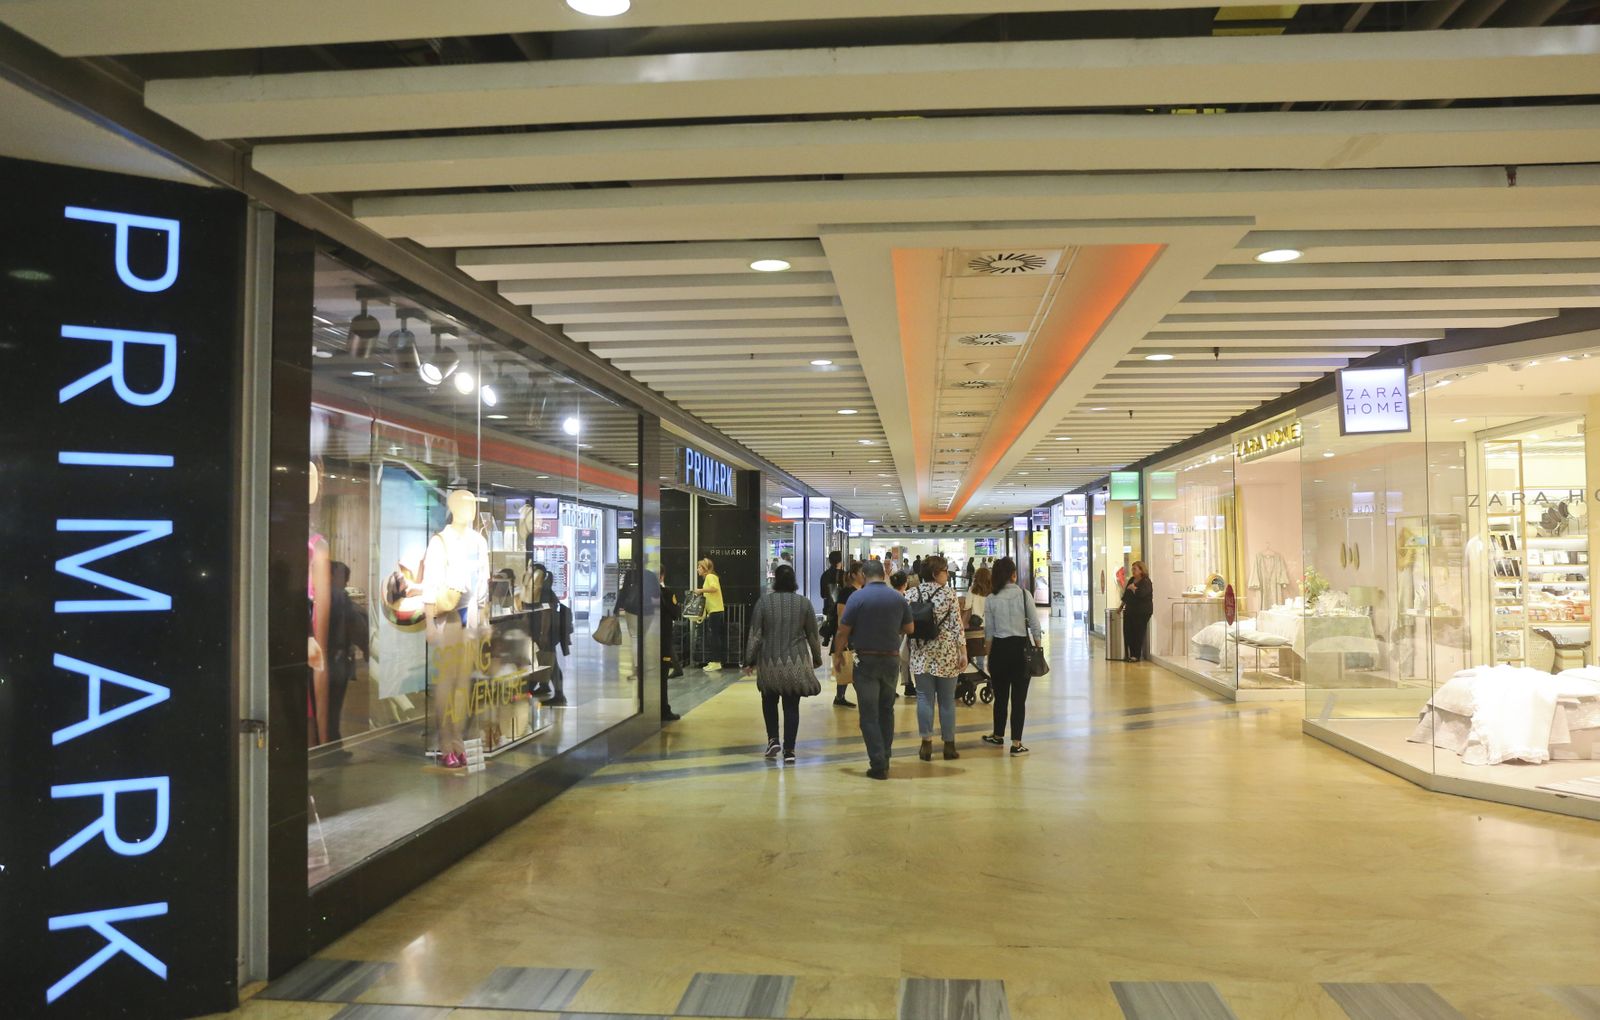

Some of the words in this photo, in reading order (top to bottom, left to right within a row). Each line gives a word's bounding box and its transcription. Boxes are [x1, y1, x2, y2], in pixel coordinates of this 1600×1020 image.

[1345, 386, 1402, 400] ZARA
[1346, 401, 1404, 415] HOME
[1236, 434, 1267, 458] ZARA
[1266, 421, 1302, 447] HOME
[685, 446, 733, 498] PRIMARK
[1467, 490, 1549, 508] ZARA
[710, 548, 748, 556] PRIMARK
[46, 205, 180, 1006] PRIMARK
